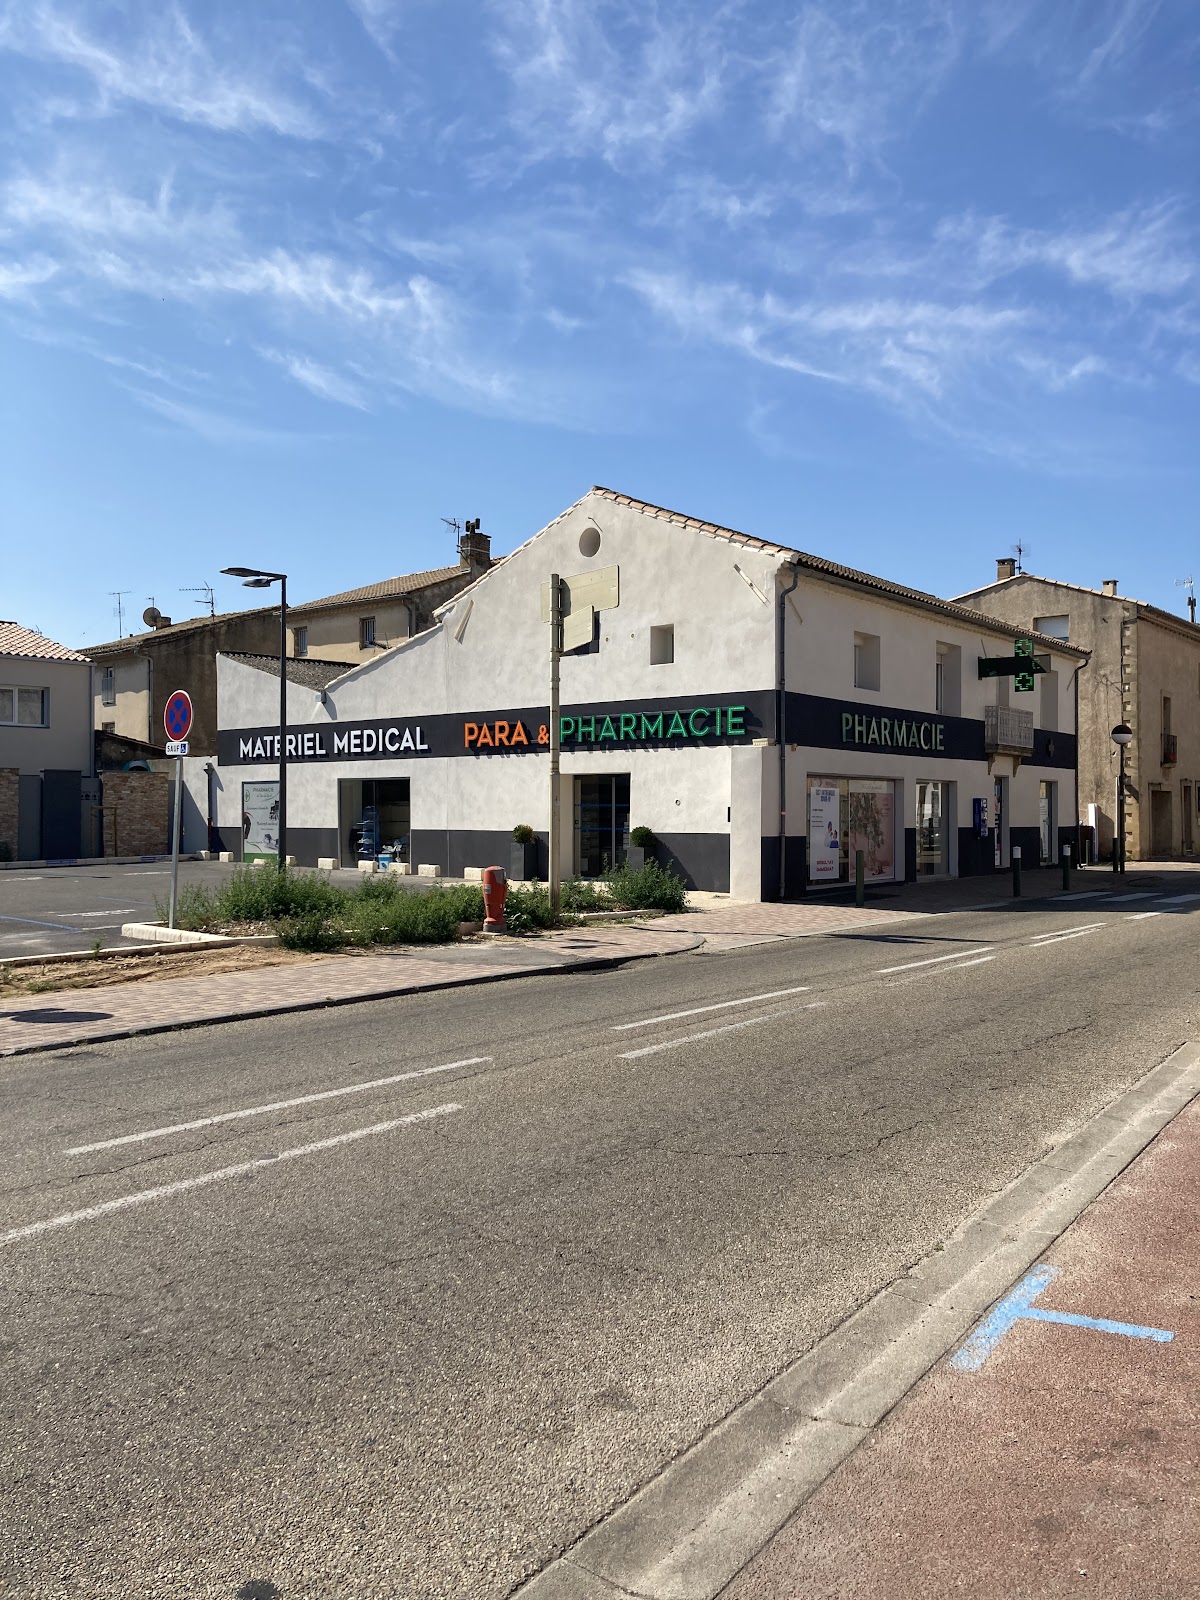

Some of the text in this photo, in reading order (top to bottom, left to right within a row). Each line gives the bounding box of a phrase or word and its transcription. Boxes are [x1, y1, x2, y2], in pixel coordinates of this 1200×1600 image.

[239, 726, 429, 758] MATERIEL MEDICAL
[464, 705, 746, 748] PARA & PHARMACIE
[841, 713, 945, 751] PHARMACIE
[167, 744, 180, 753] SAUF
